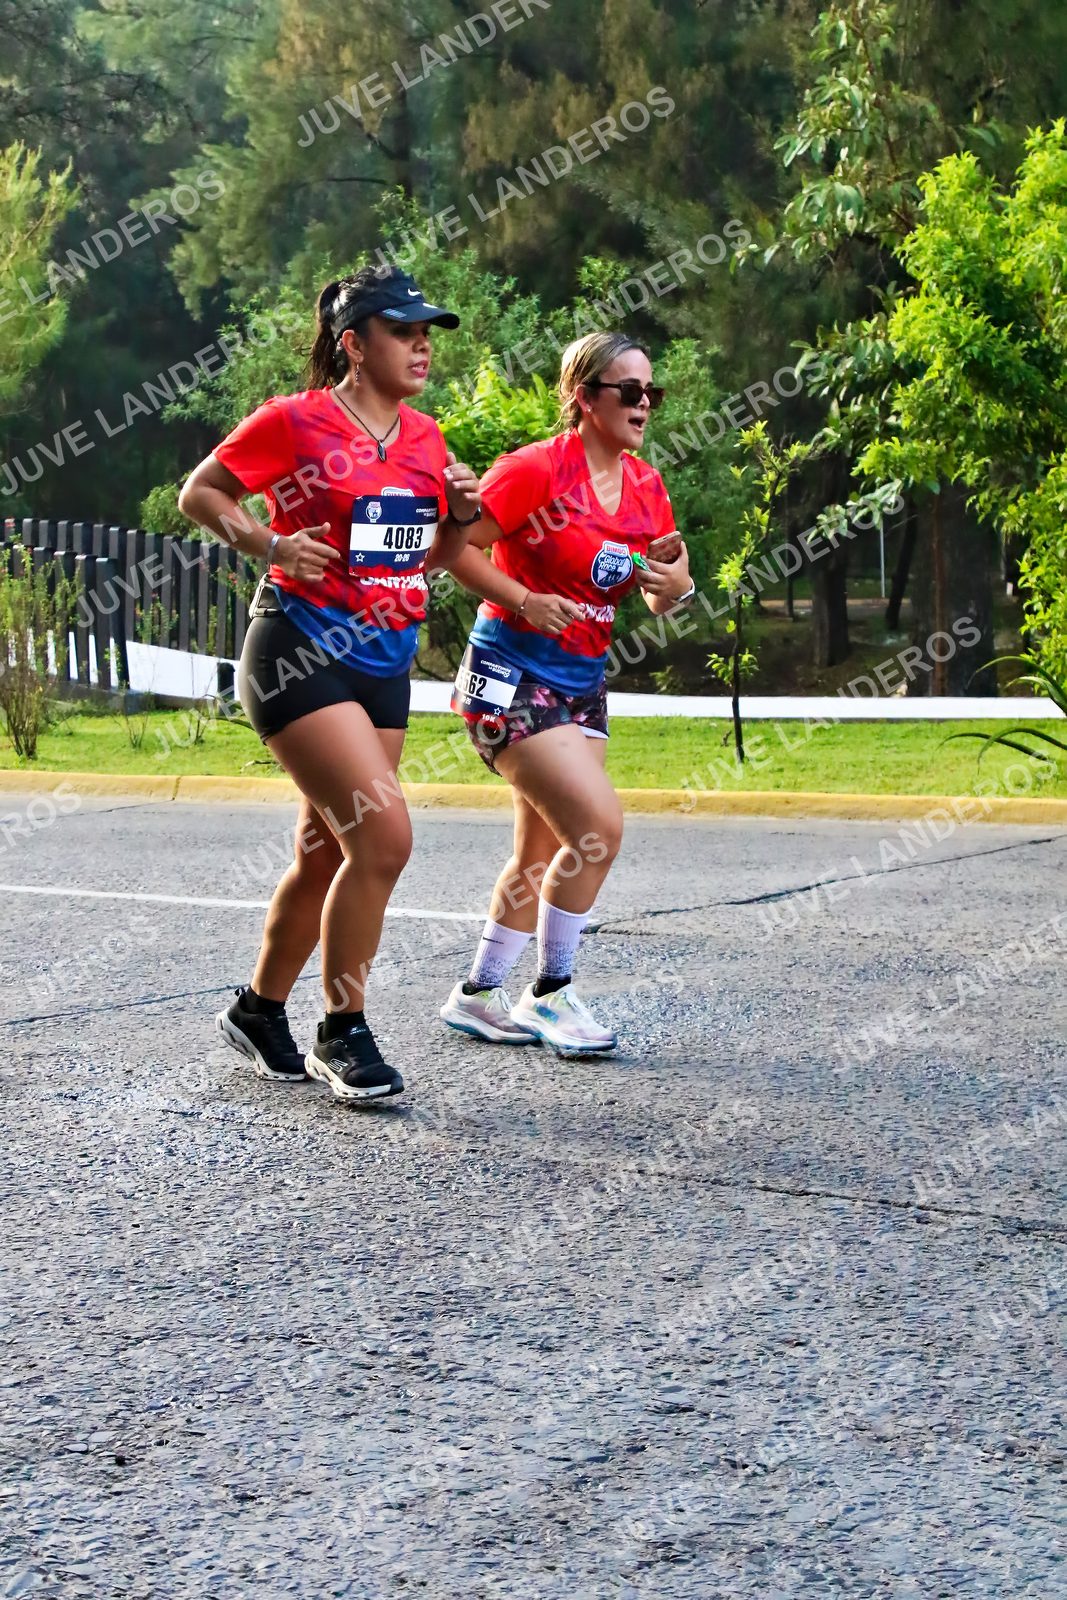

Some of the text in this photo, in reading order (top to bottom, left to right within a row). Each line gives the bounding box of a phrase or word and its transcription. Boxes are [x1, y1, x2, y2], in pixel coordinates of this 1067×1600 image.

[383, 526, 424, 549] 4083
[598, 561, 616, 572] Race
[604, 555, 626, 567] Global
[482, 713, 496, 723] 10K
